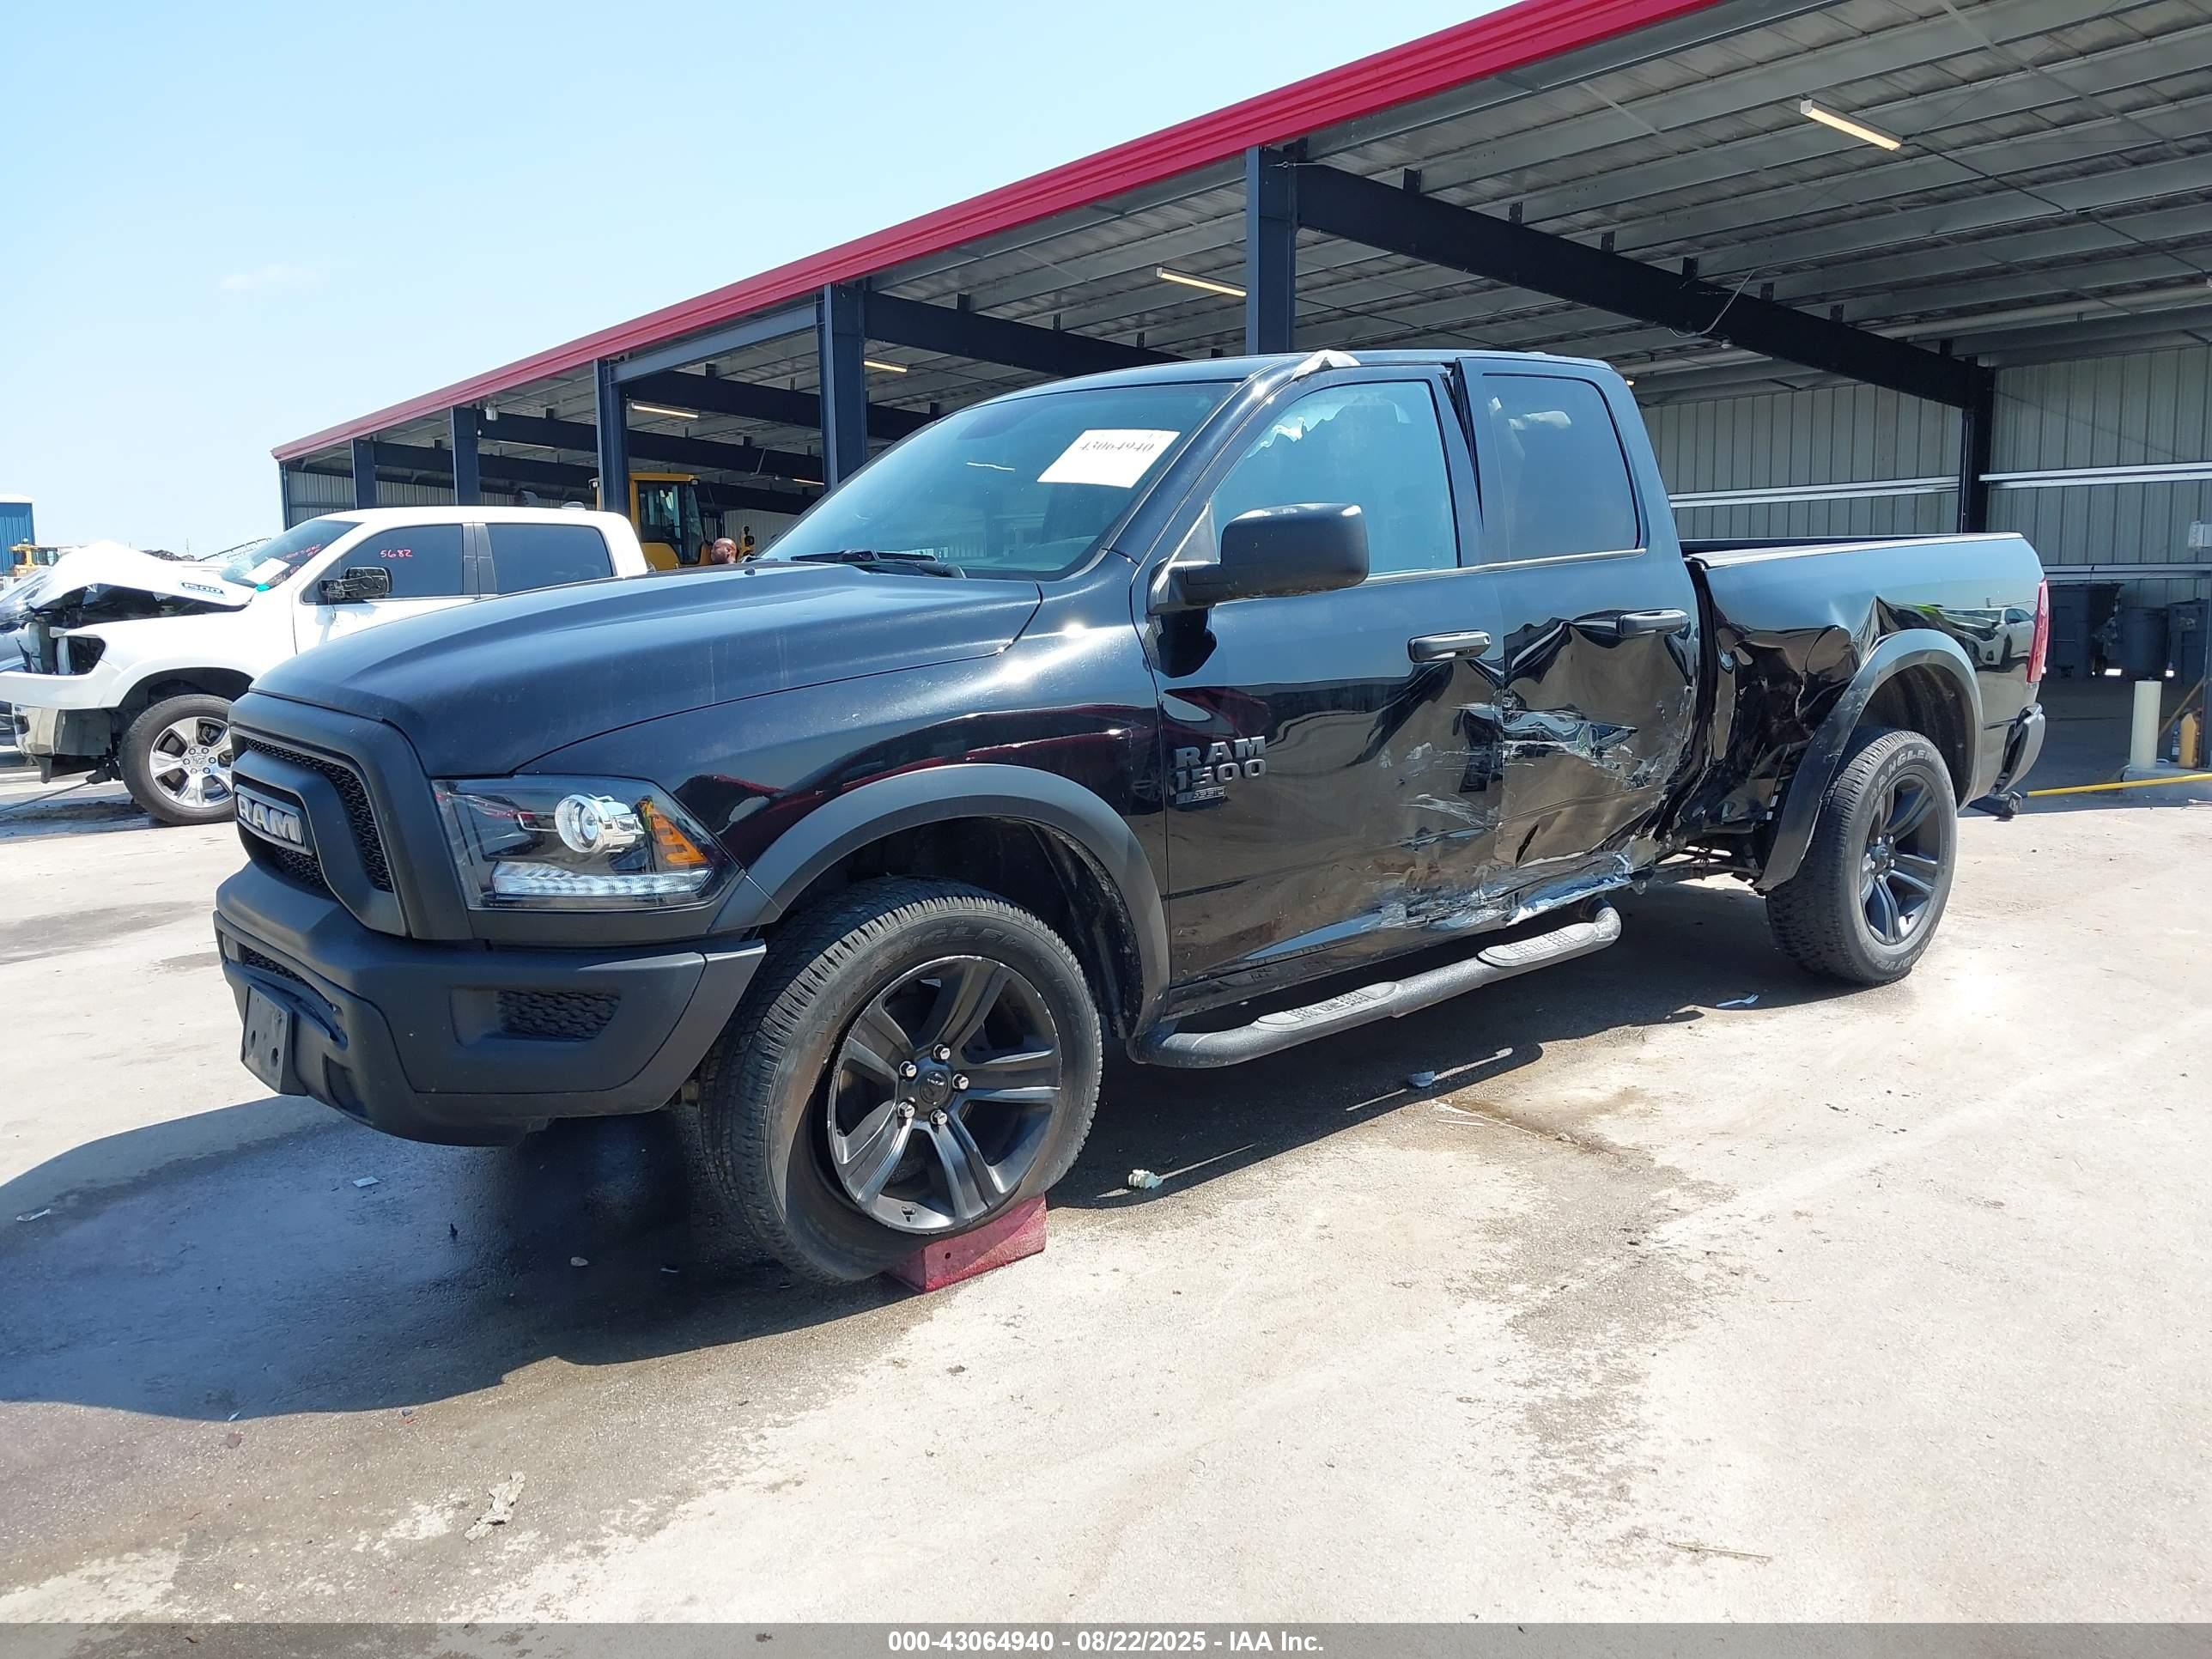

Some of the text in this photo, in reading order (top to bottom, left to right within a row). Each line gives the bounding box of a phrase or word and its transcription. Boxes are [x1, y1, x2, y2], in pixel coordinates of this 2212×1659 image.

[380, 549, 413, 558] 5682
[1176, 736, 1266, 769] RAM
[1176, 758, 1267, 792] 1500
[237, 793, 302, 844] RAM
